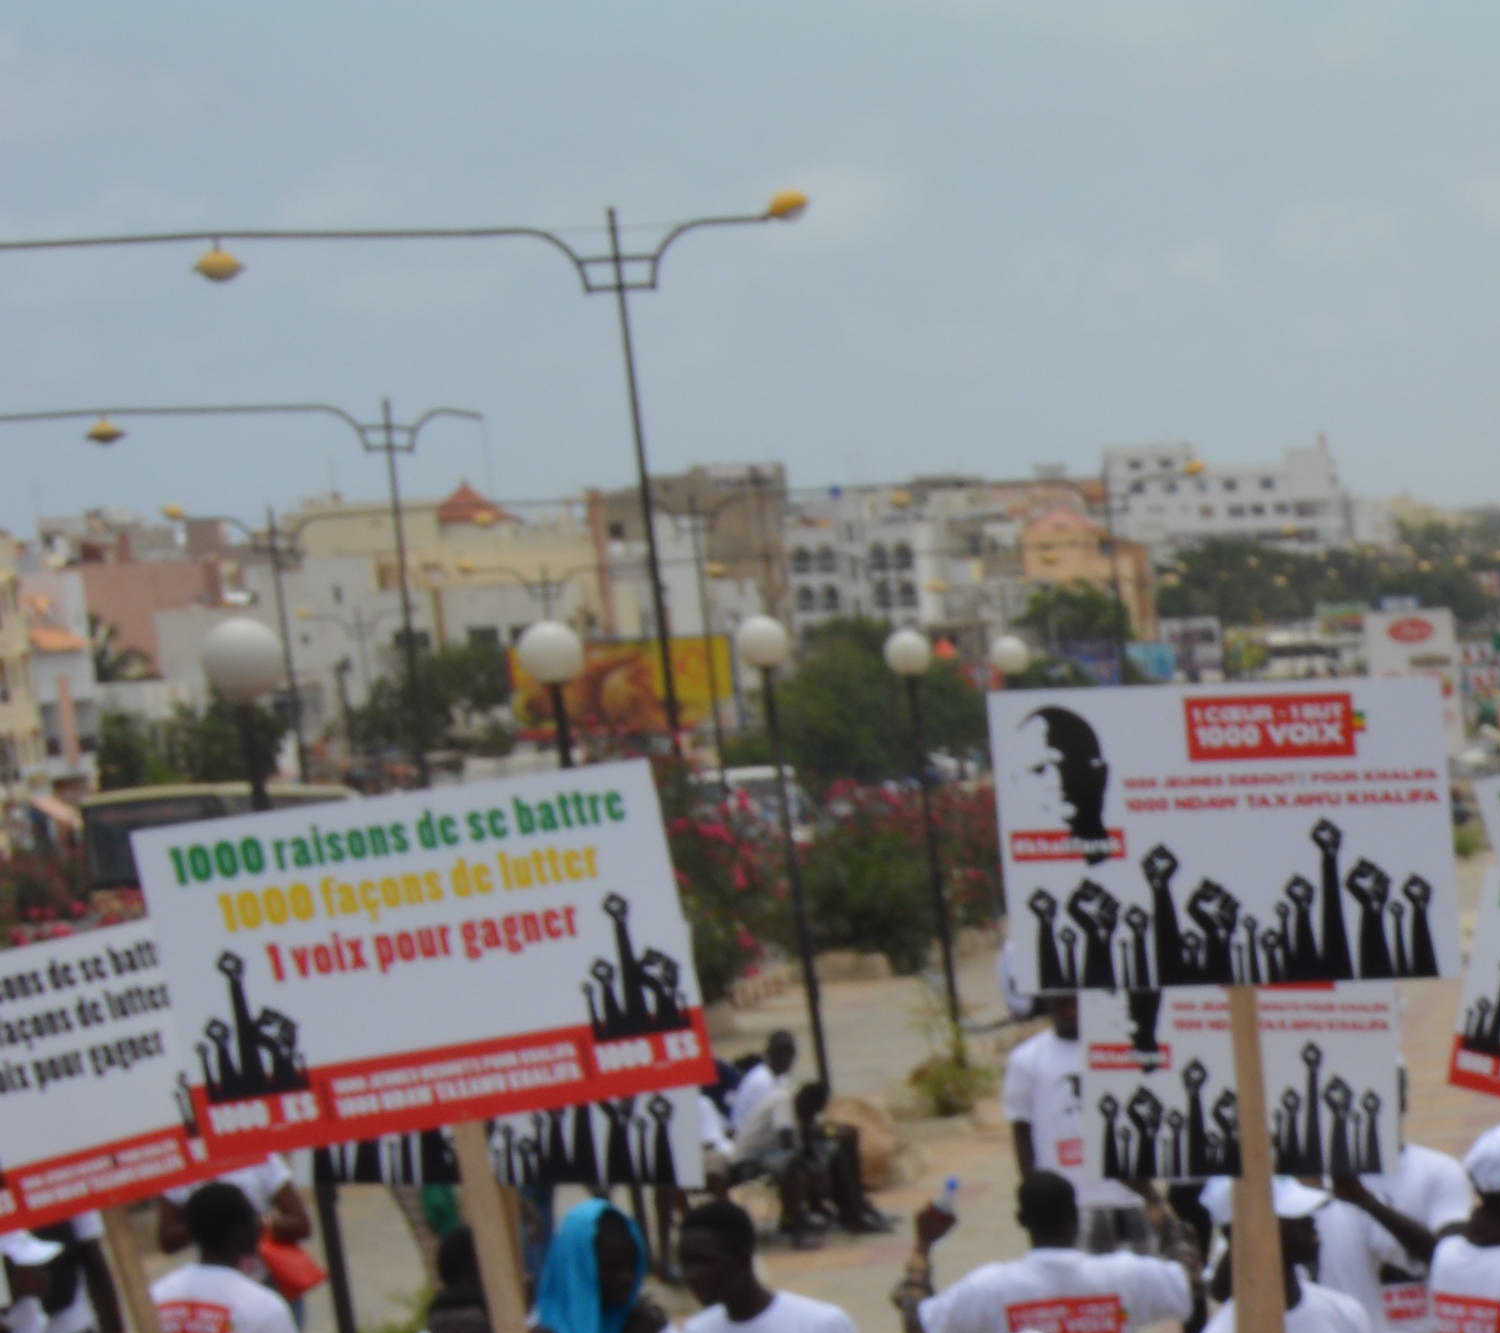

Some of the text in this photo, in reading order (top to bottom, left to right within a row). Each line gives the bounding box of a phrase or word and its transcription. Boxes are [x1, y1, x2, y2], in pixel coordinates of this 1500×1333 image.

[1198, 722, 1346, 748] 1000 VOIX
[169, 789, 628, 887] 1000 raisons de se battre
[216, 845, 599, 934] 1000 façons de lutter
[289, 931, 368, 979] voix
[374, 922, 453, 974] pour
[458, 903, 580, 961] gagner
[0, 1008, 73, 1050] açons
